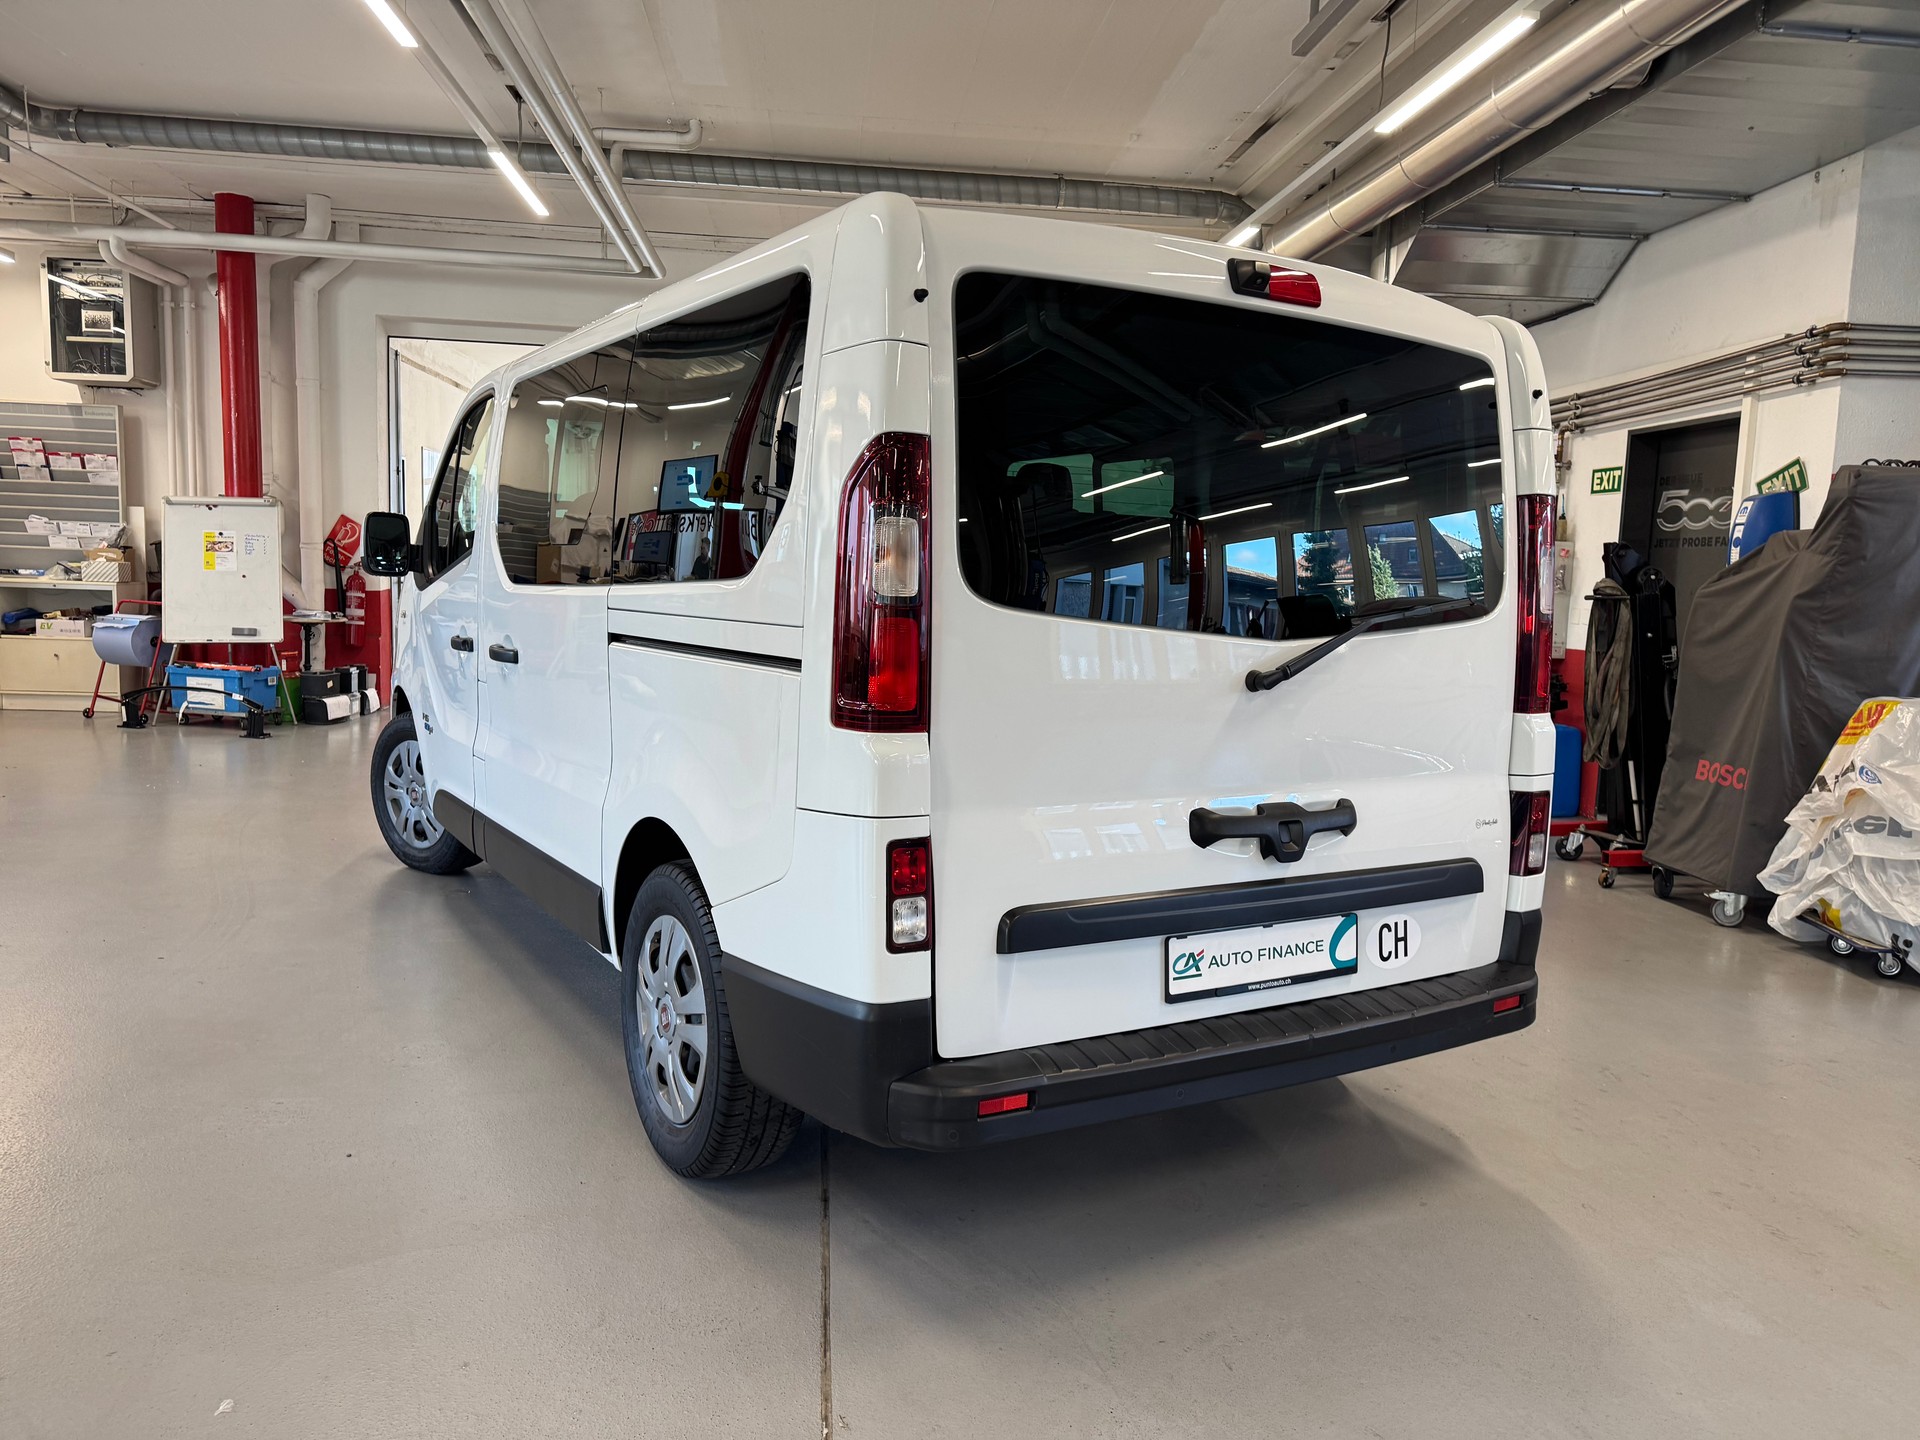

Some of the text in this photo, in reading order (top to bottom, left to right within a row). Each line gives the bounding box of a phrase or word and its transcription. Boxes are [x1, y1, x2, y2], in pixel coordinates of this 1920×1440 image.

[1593, 470, 1621, 491] EXIT
[1681, 536, 1712, 548] PROBE
[1695, 759, 1750, 791] BOSC
[1379, 919, 1408, 962] CH
[1208, 939, 1324, 969] AUTO FINANCE
[1247, 978, 1292, 990] www.puntoauto.ch
